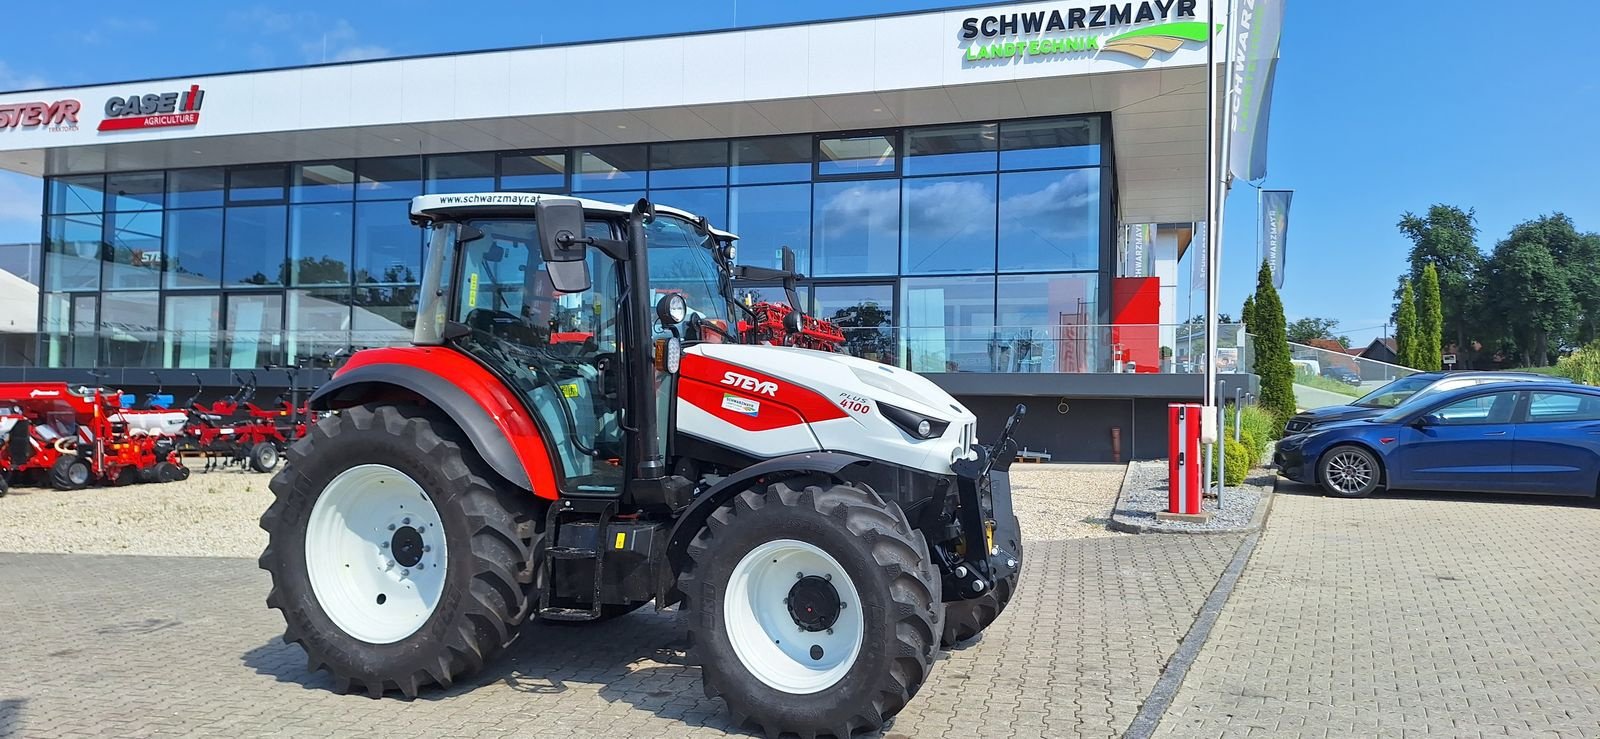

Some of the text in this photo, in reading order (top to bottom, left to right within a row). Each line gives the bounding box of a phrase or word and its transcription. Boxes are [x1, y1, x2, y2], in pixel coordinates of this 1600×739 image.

[962, 0, 1196, 38] SCHWARZMAYR
[966, 36, 1099, 61] LANDTECHNIK
[104, 92, 179, 118] CASE
[144, 114, 195, 126] AGRICULTURE
[720, 371, 779, 397] STEYR
[839, 392, 868, 404] PLUS
[840, 399, 870, 414] 4100
